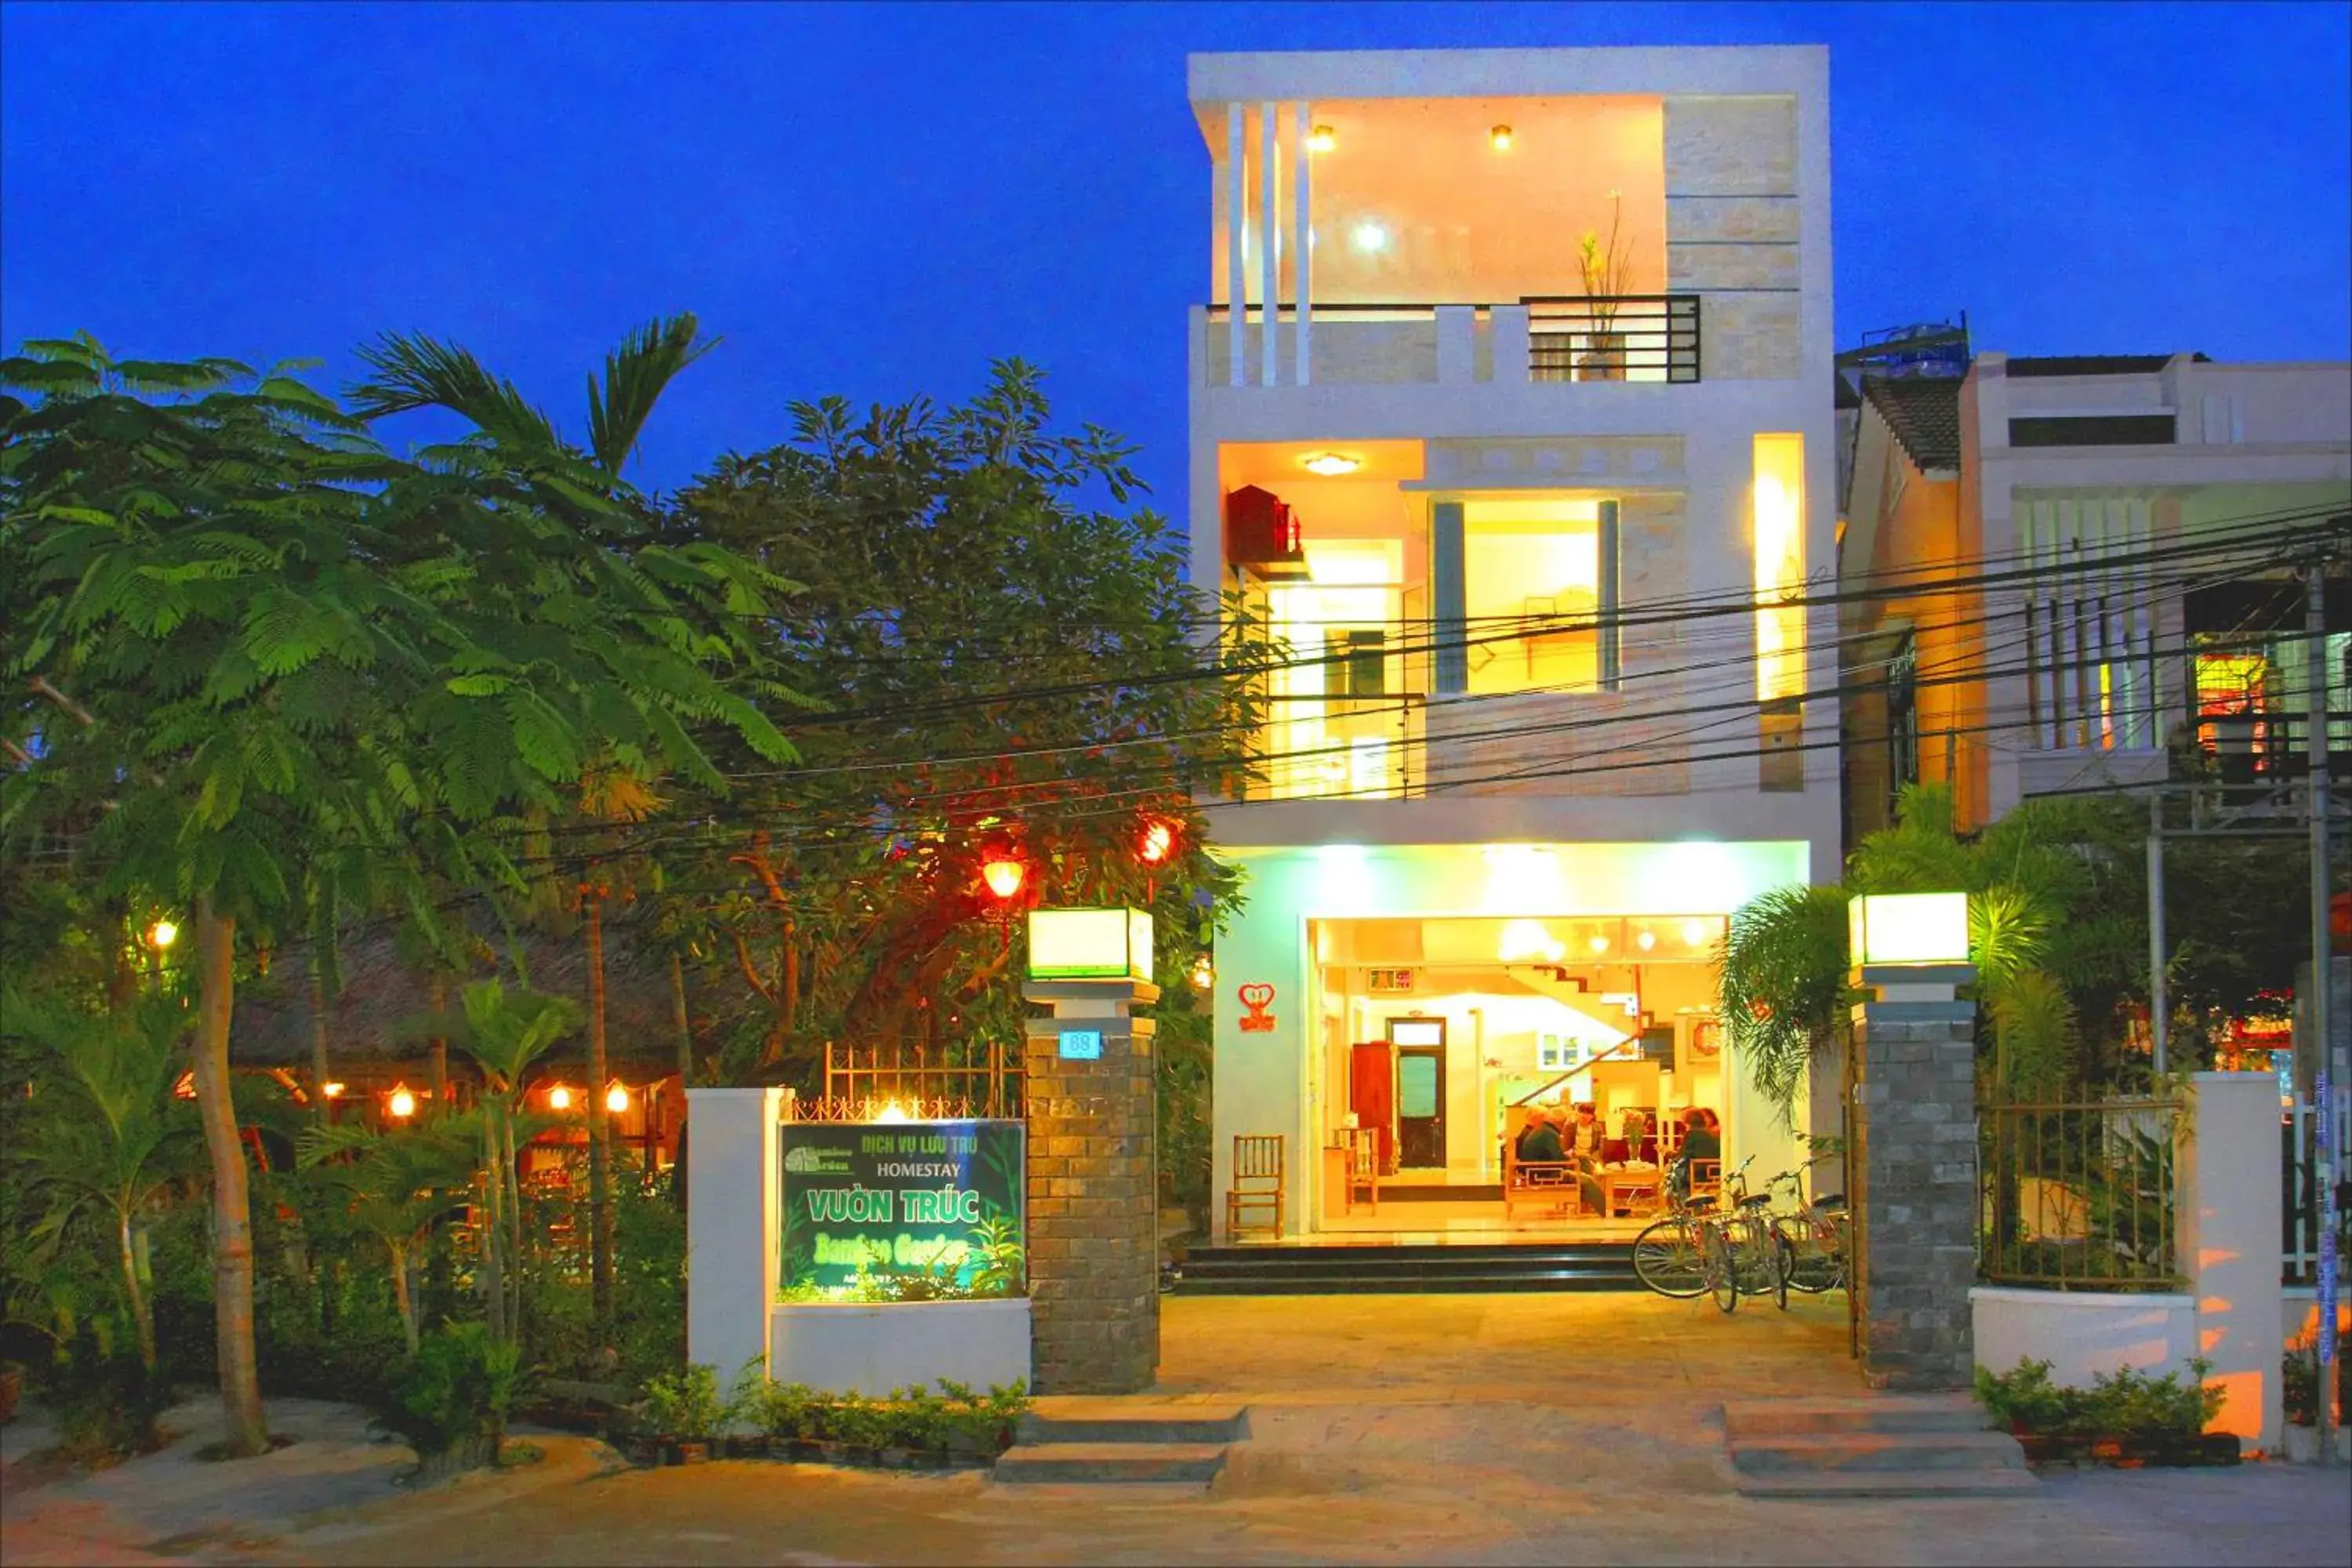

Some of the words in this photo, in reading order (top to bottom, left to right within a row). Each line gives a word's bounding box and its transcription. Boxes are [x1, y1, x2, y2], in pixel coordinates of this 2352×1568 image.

[877, 1163, 961, 1178] HOMESTAY
[807, 1182, 893, 1223] VƯỜN
[900, 1183, 979, 1224] TRÚC
